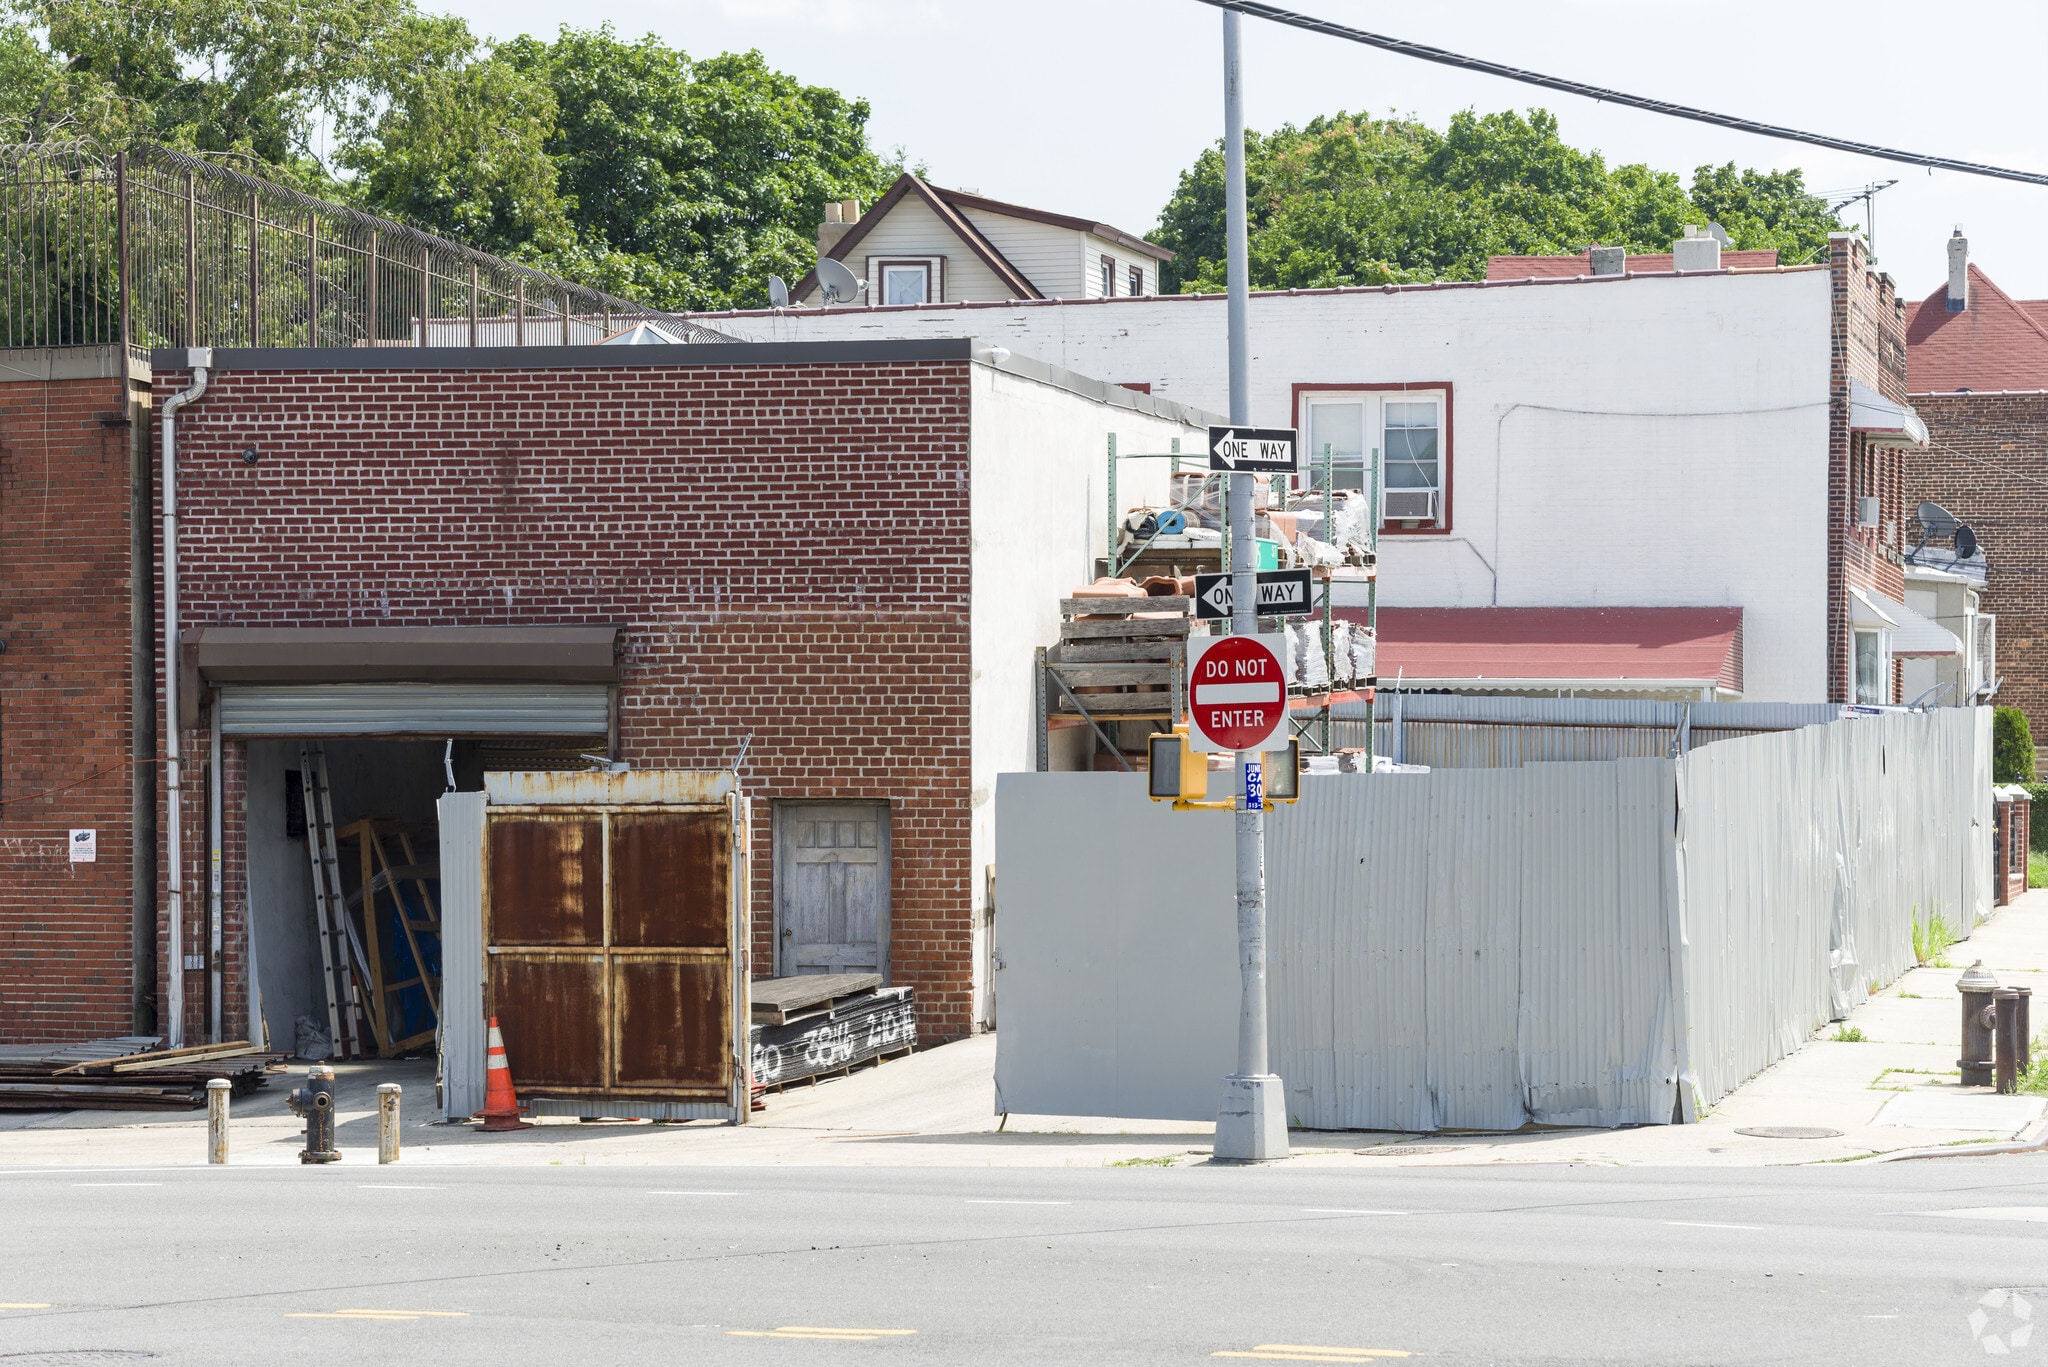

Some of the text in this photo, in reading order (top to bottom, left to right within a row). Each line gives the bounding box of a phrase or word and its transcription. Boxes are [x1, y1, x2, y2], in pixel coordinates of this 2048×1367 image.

[1223, 441, 1286, 460] ONE WAY
[1213, 584, 1296, 605] ON WAY
[1206, 658, 1268, 678] DO NOT
[1211, 709, 1265, 728] ENTER
